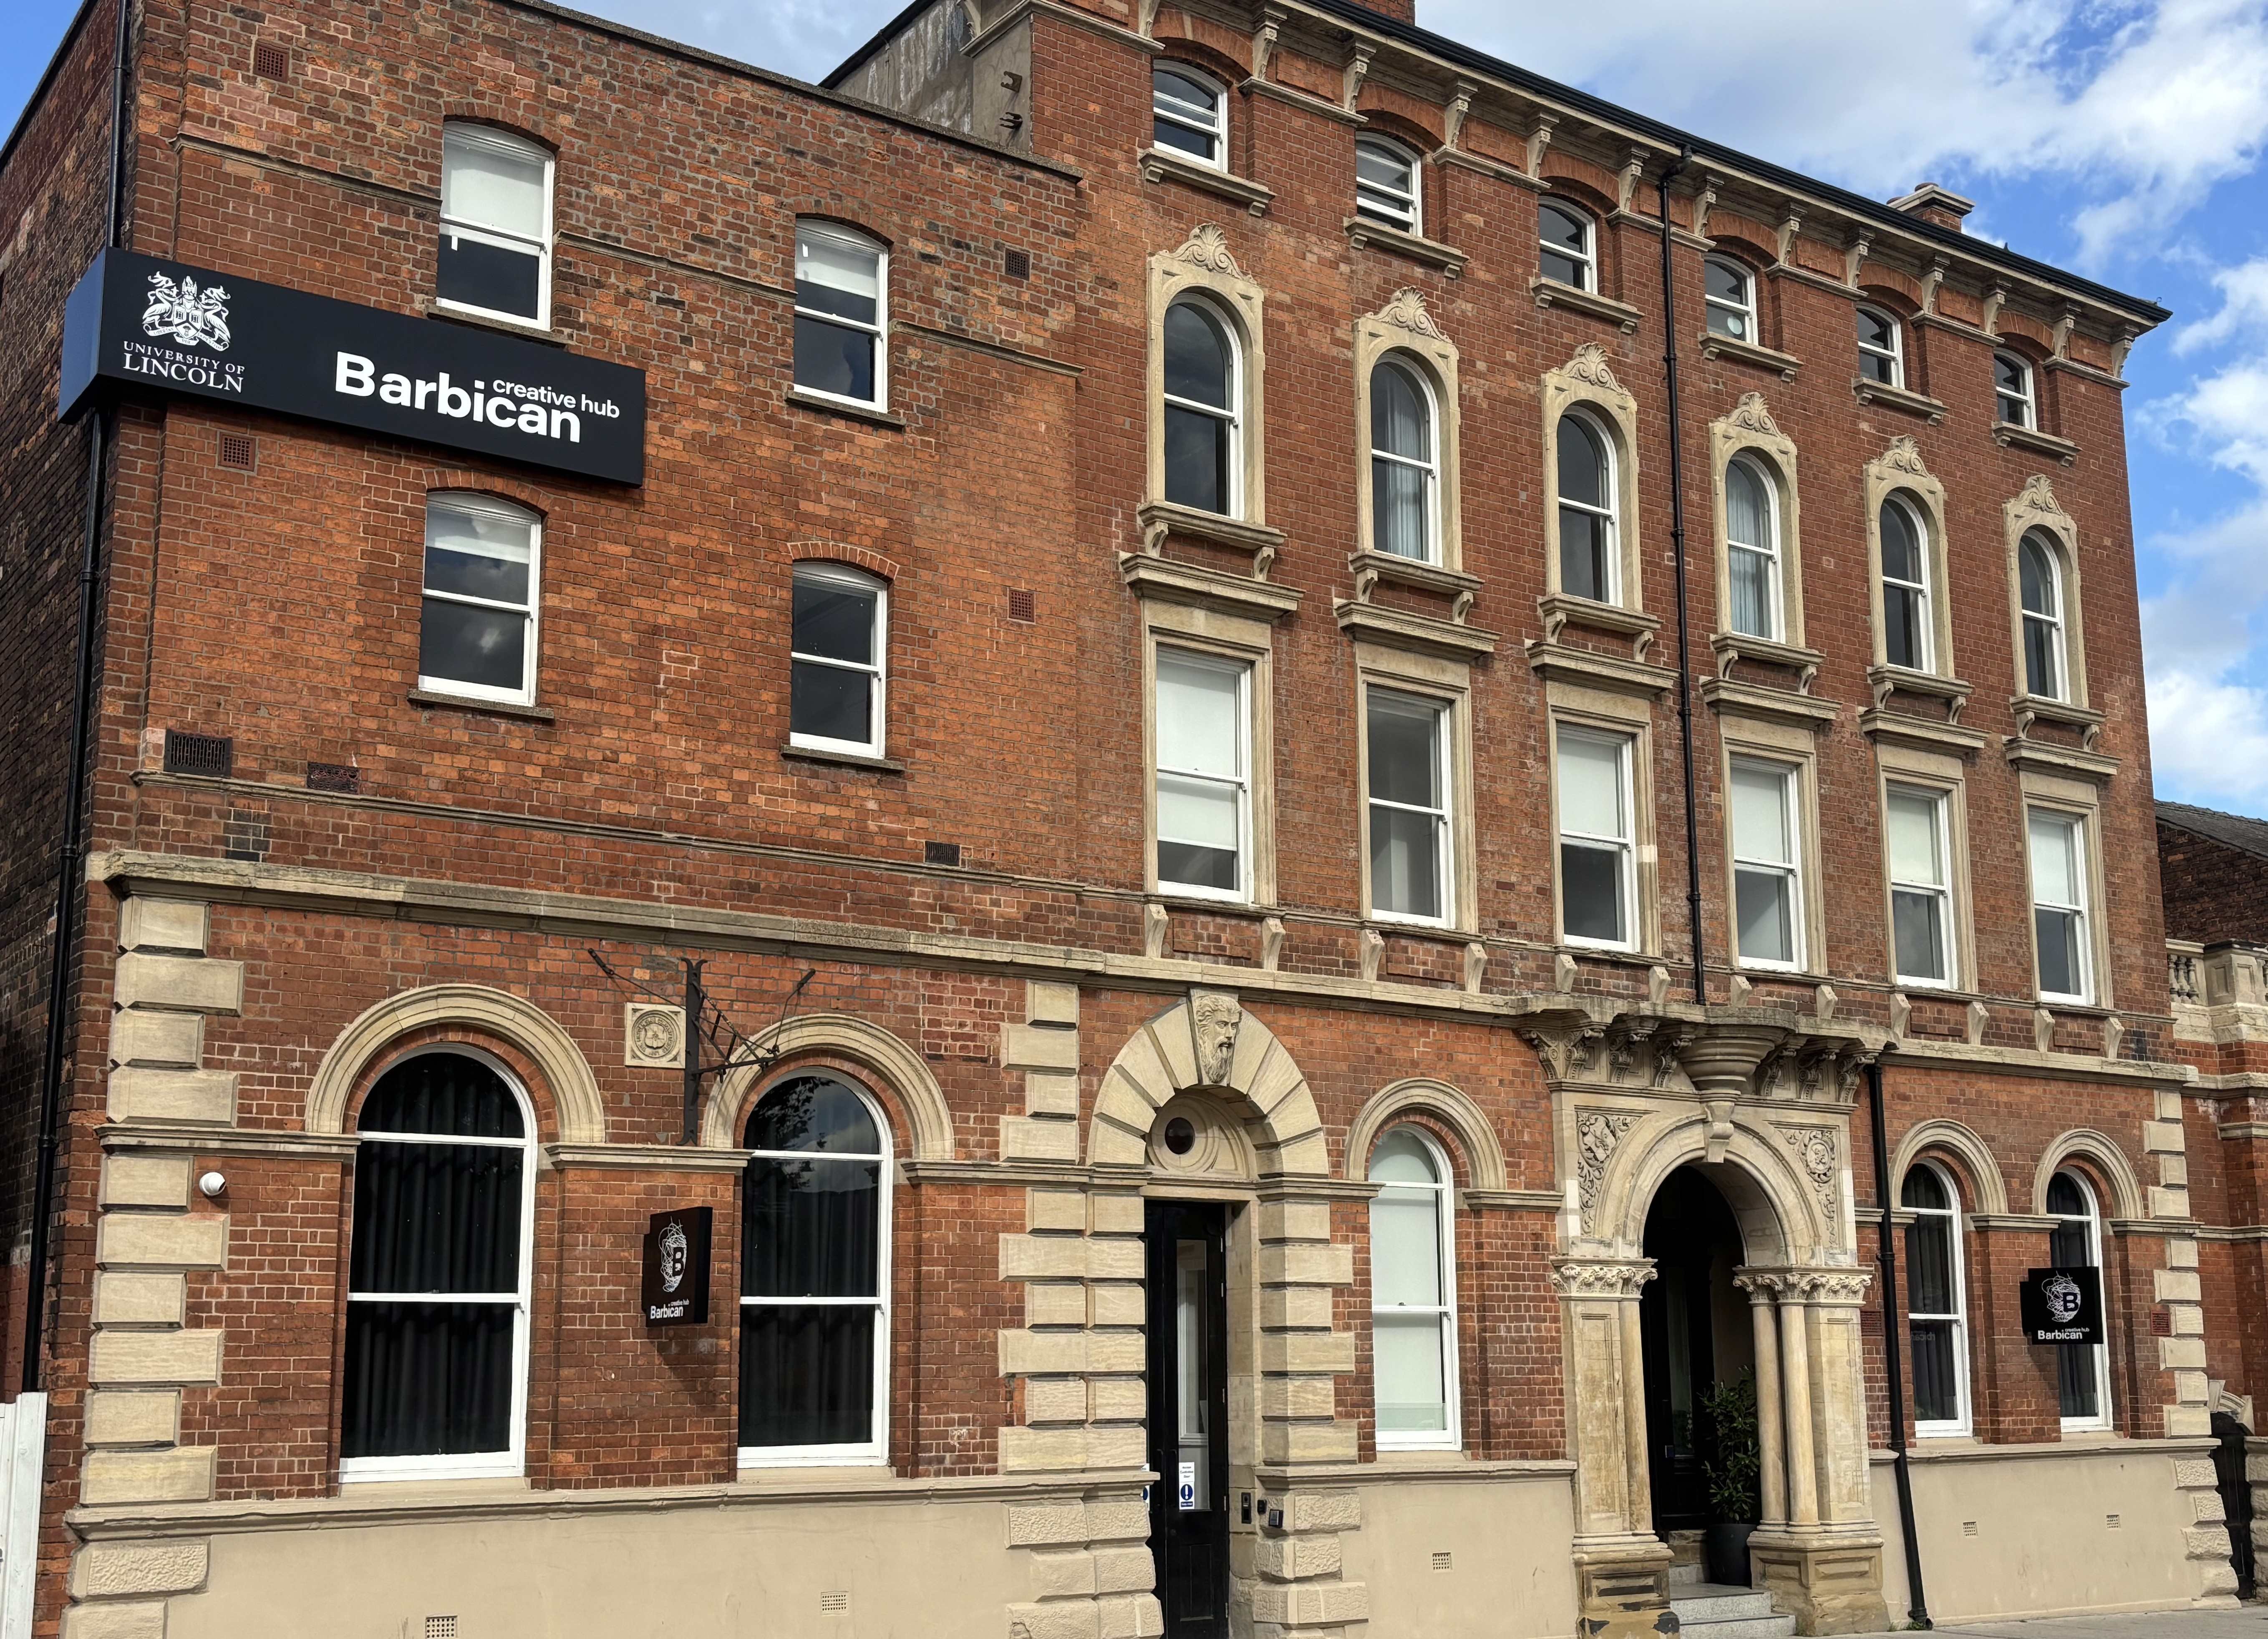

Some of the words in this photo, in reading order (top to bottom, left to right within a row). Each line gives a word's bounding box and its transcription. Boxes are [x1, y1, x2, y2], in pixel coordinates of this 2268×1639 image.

[123, 341, 220, 369] UNIVERSITY
[225, 363, 245, 374] OF
[123, 352, 244, 393] LINCOLN
[335, 351, 580, 443] Barbican
[493, 380, 576, 408] creative
[581, 394, 620, 418] hub
[650, 1304, 684, 1319] Barbican
[2038, 1329, 2083, 1339] Barbican
